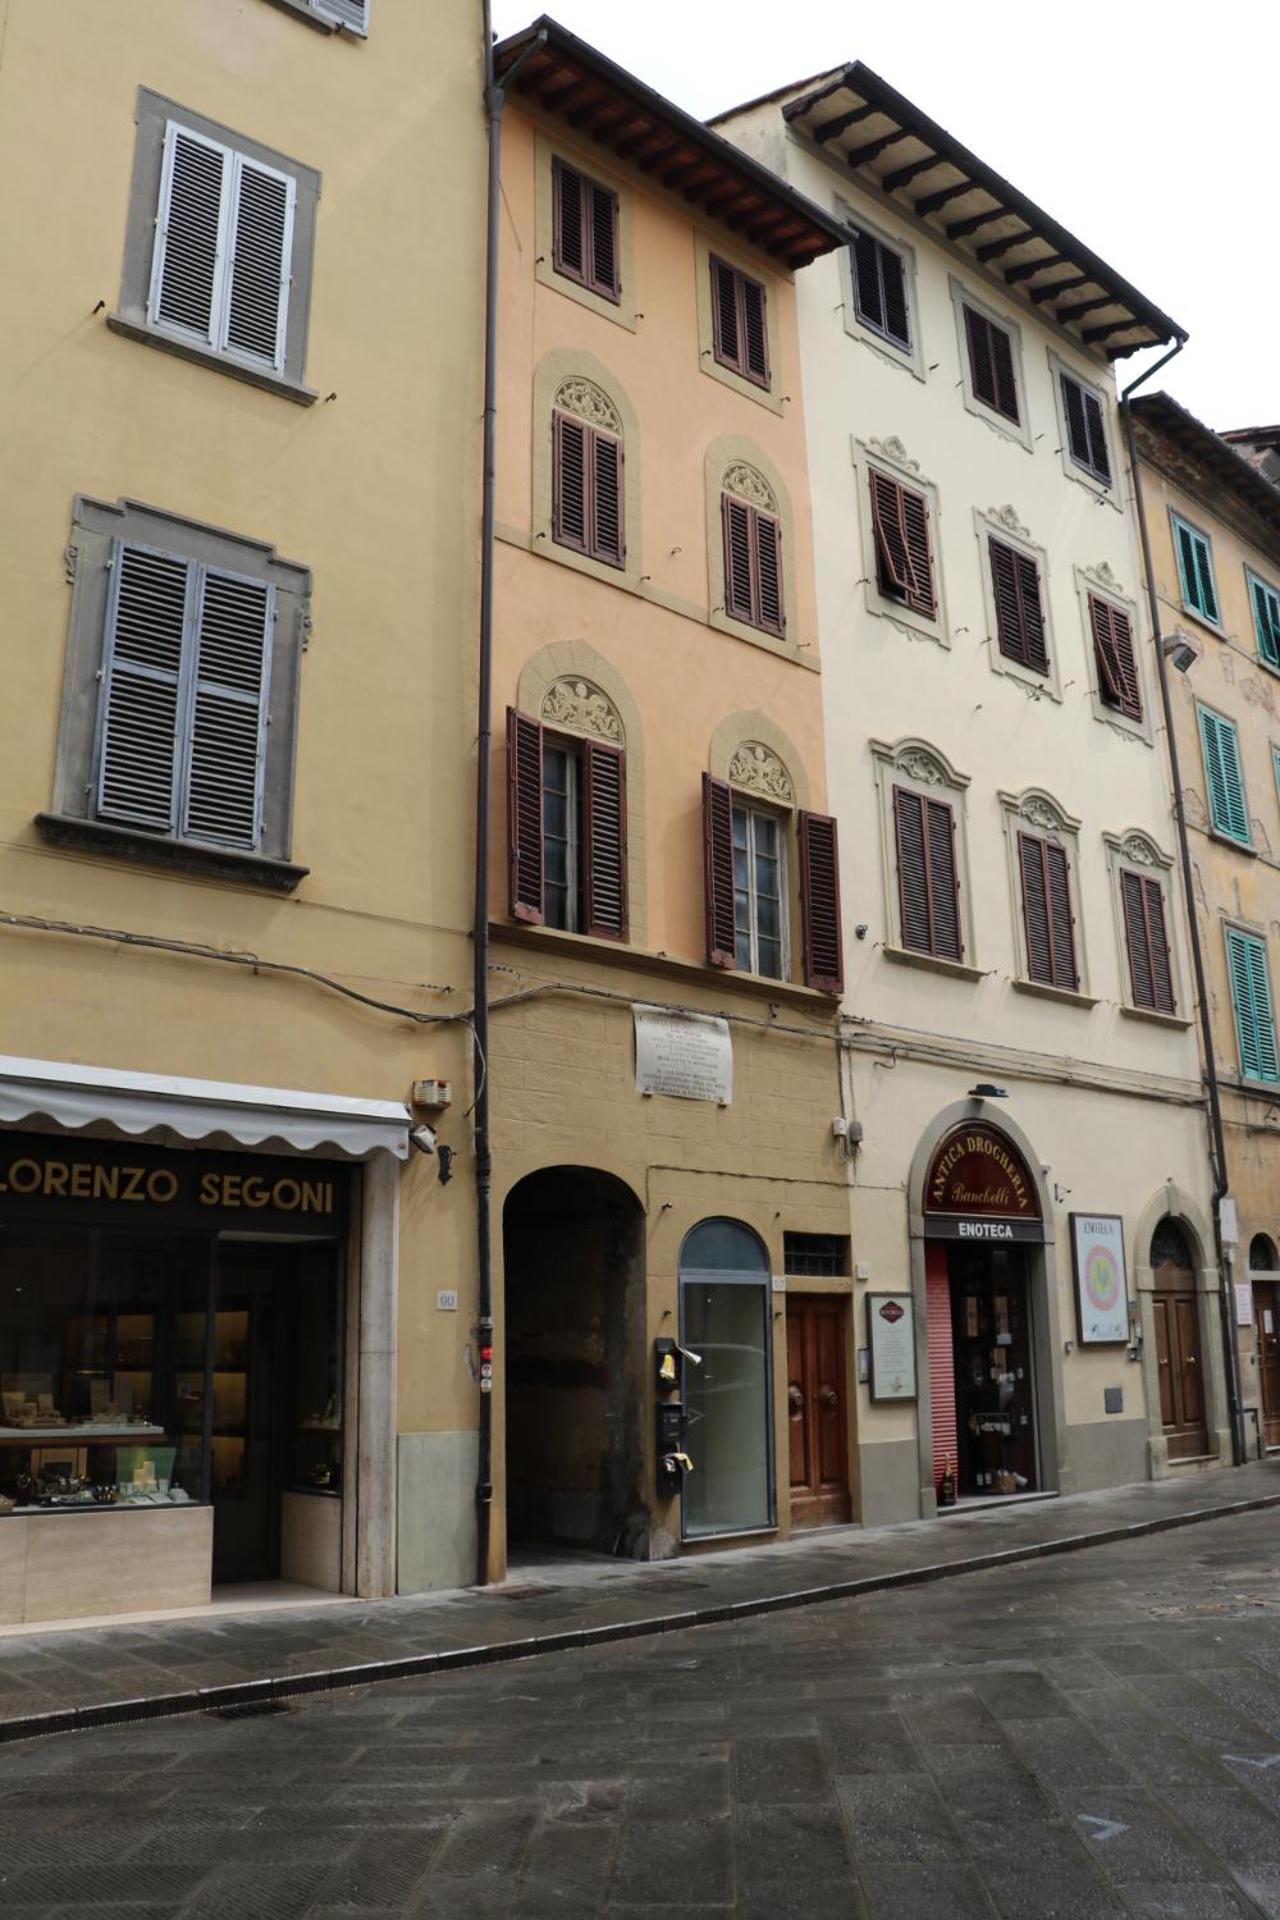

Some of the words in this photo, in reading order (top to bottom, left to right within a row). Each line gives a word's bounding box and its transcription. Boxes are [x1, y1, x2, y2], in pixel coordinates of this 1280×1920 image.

[933, 1142, 966, 1202] ANTICA
[966, 1136, 1028, 1209] DROGHERIA
[200, 1174, 333, 1213] SEGONI
[958, 1222, 1013, 1238] ENOTECA
